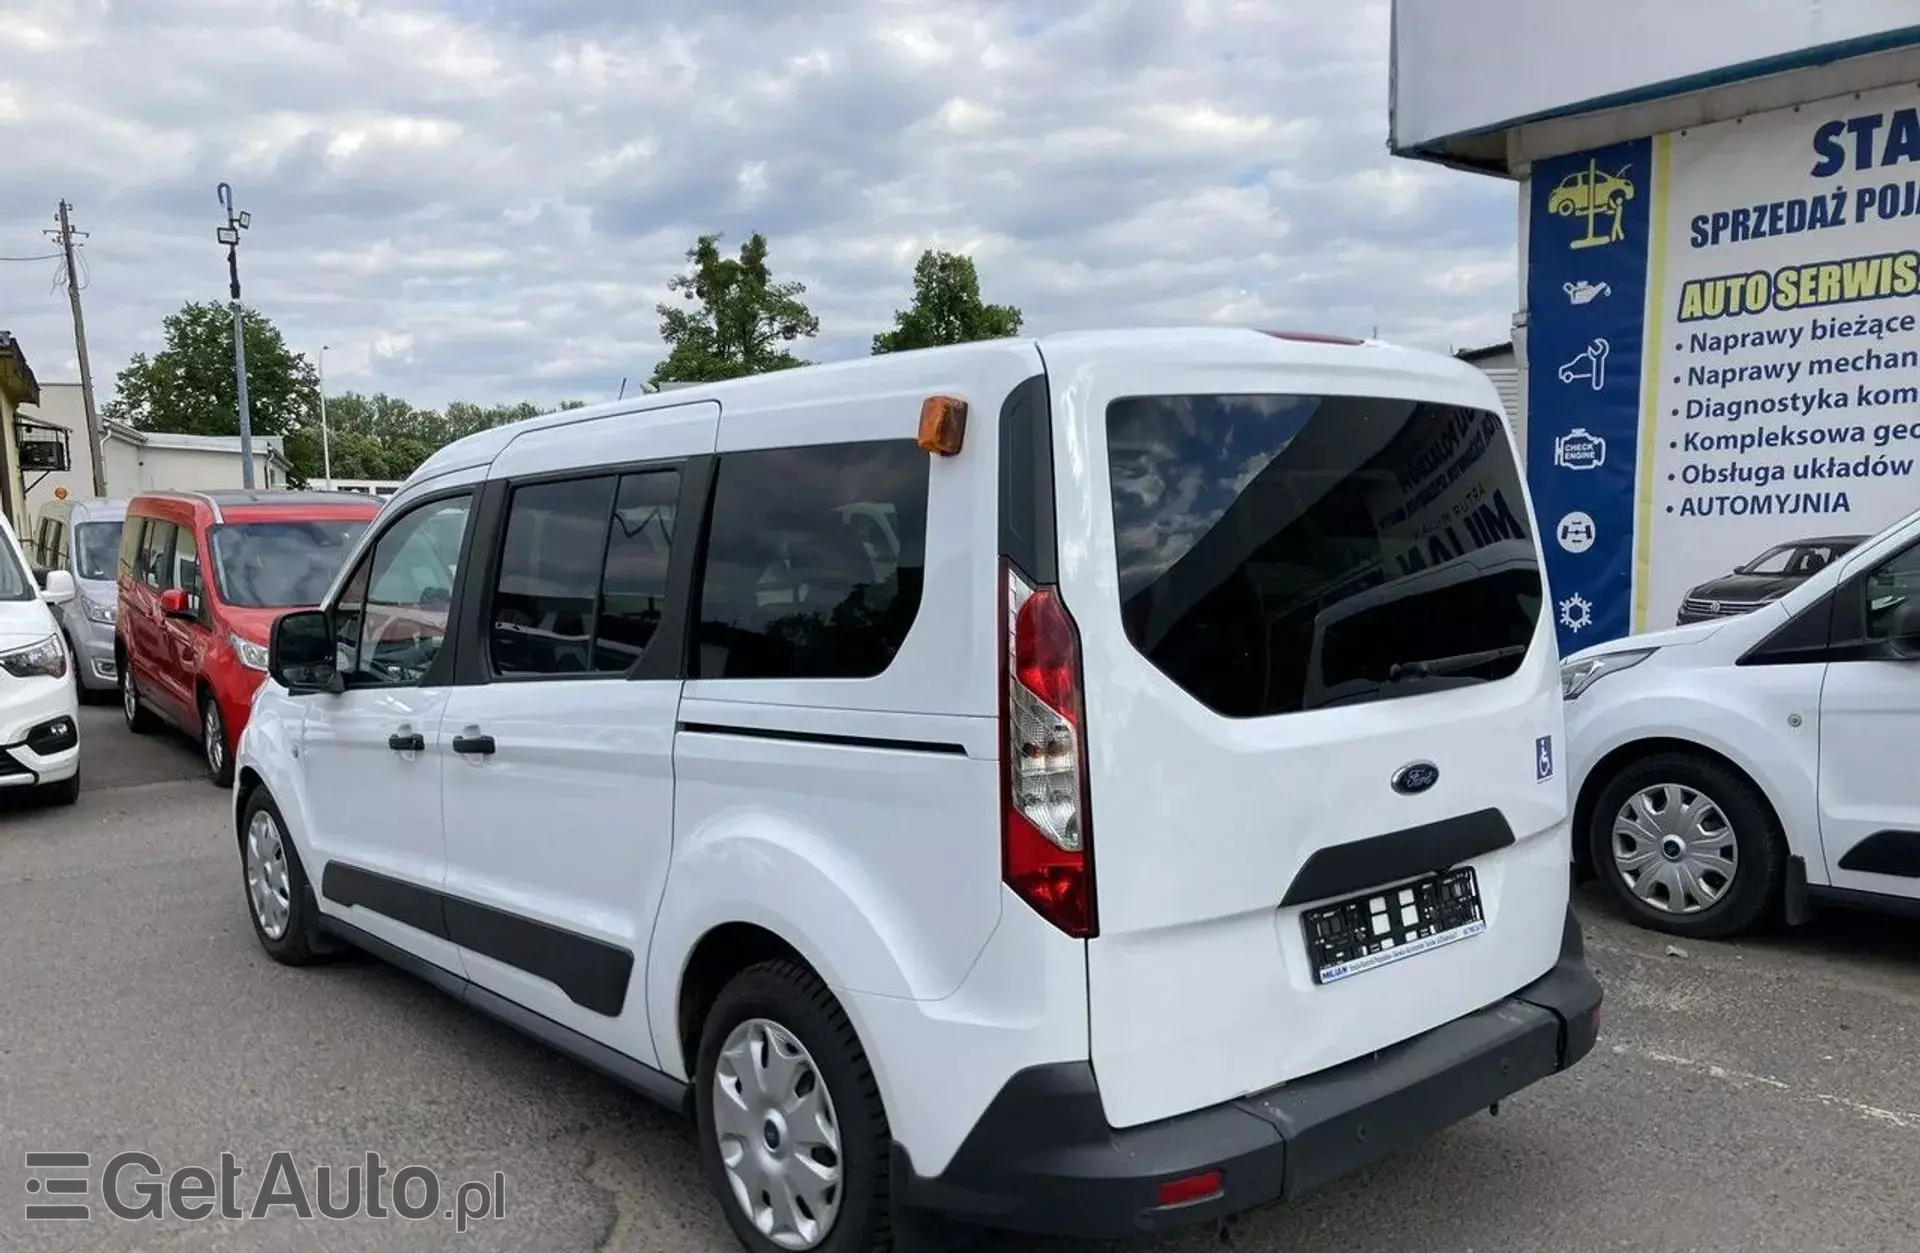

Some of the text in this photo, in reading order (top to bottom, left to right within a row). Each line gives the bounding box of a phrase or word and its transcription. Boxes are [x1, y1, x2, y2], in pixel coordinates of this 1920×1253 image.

[1810, 108, 1920, 178] STA
[1690, 180, 1920, 249] SPRZEDAŻ POJ
[1678, 249, 1920, 323] AUTO SERWIS
[1690, 313, 1915, 356] Naprawy bieżące
[1688, 347, 1918, 389] Naprawy mechan
[1686, 383, 1919, 422] Diagnostyka kom
[1564, 443, 1594, 452] CHECK
[1564, 451, 1596, 461] ENGINE
[1684, 424, 1865, 454] Kompleksowa
[1682, 454, 1914, 487] Obsługa układów
[1680, 492, 1851, 517] AUTOMYJNIA
[1406, 768, 1433, 788] Ford
